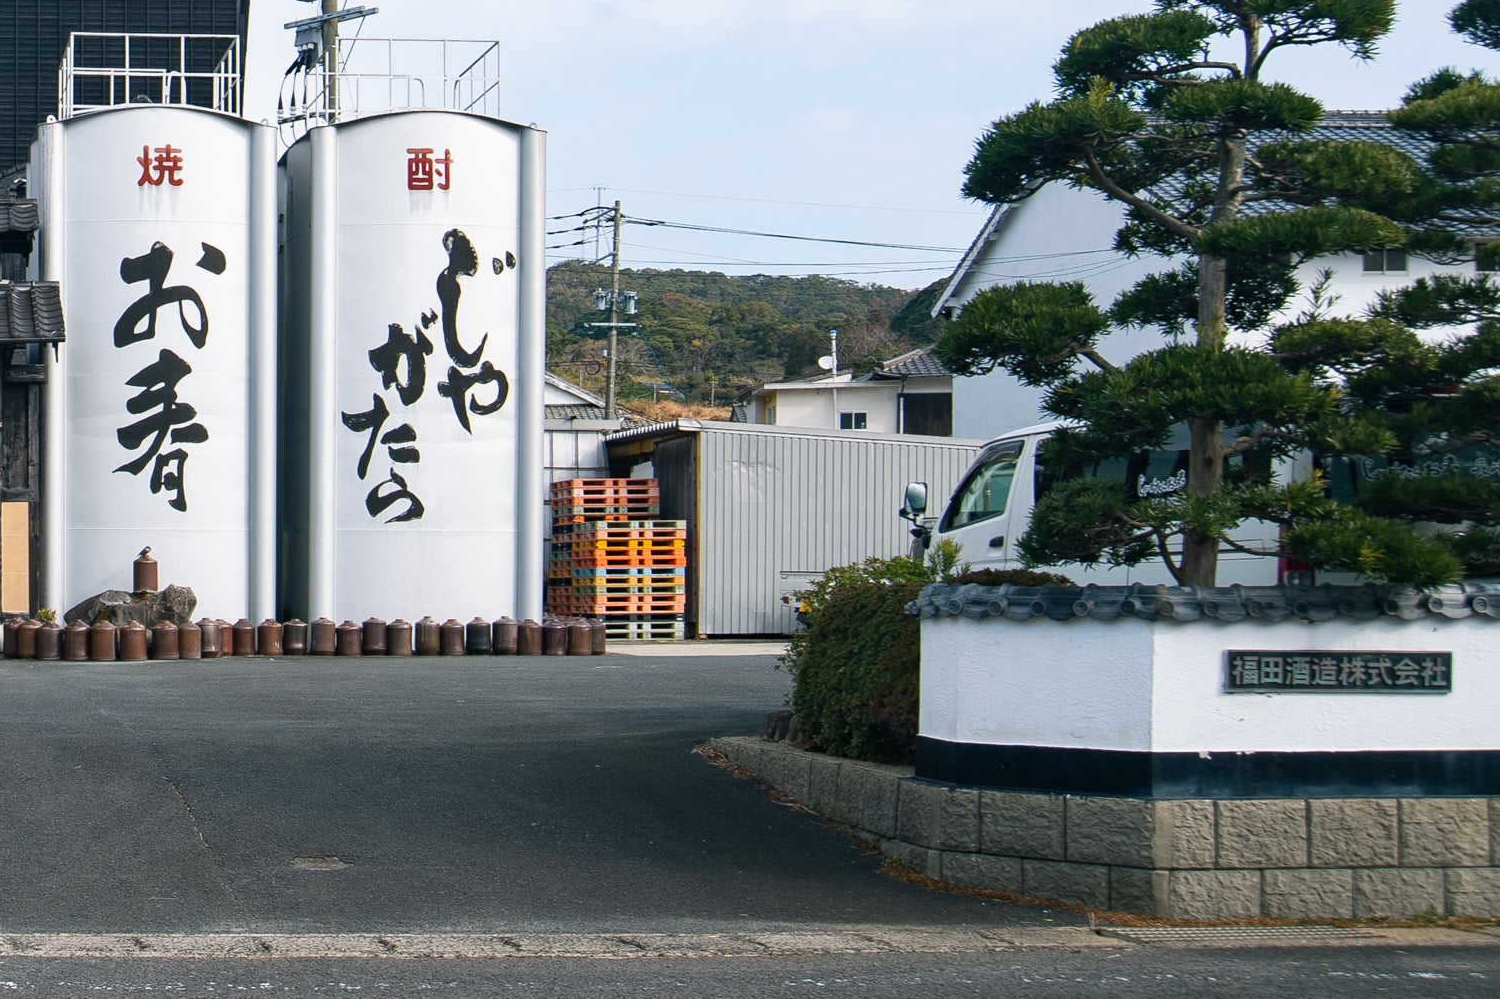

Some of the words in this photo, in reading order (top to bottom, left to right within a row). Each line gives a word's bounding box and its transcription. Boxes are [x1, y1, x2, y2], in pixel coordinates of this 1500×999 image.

[136, 144, 184, 187] 焼
[406, 147, 454, 191] 酎
[1232, 655, 1448, 687] 福田酒造株式会社
